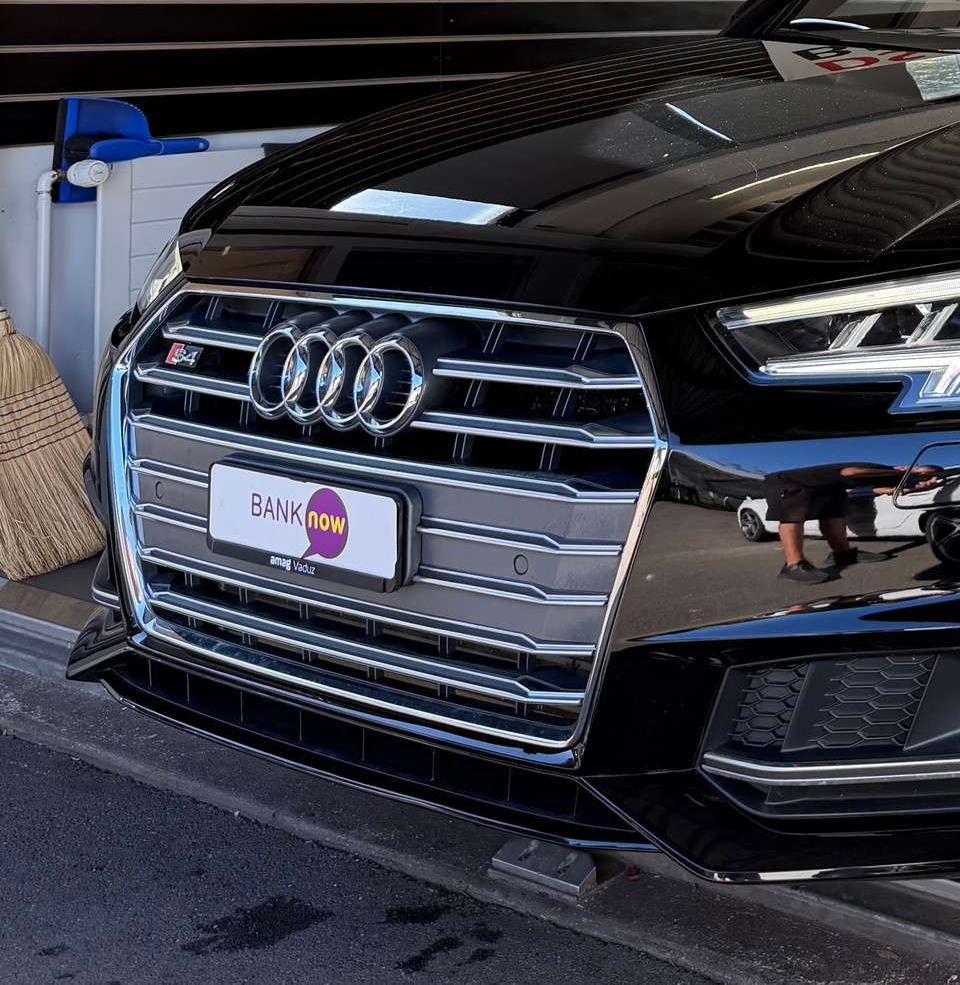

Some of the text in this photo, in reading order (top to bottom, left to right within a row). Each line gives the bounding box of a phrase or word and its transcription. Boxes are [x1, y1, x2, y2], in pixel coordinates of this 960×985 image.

[171, 347, 198, 365] S4
[251, 492, 346, 535] BANK now
[270, 555, 316, 575] amag Vaduz
